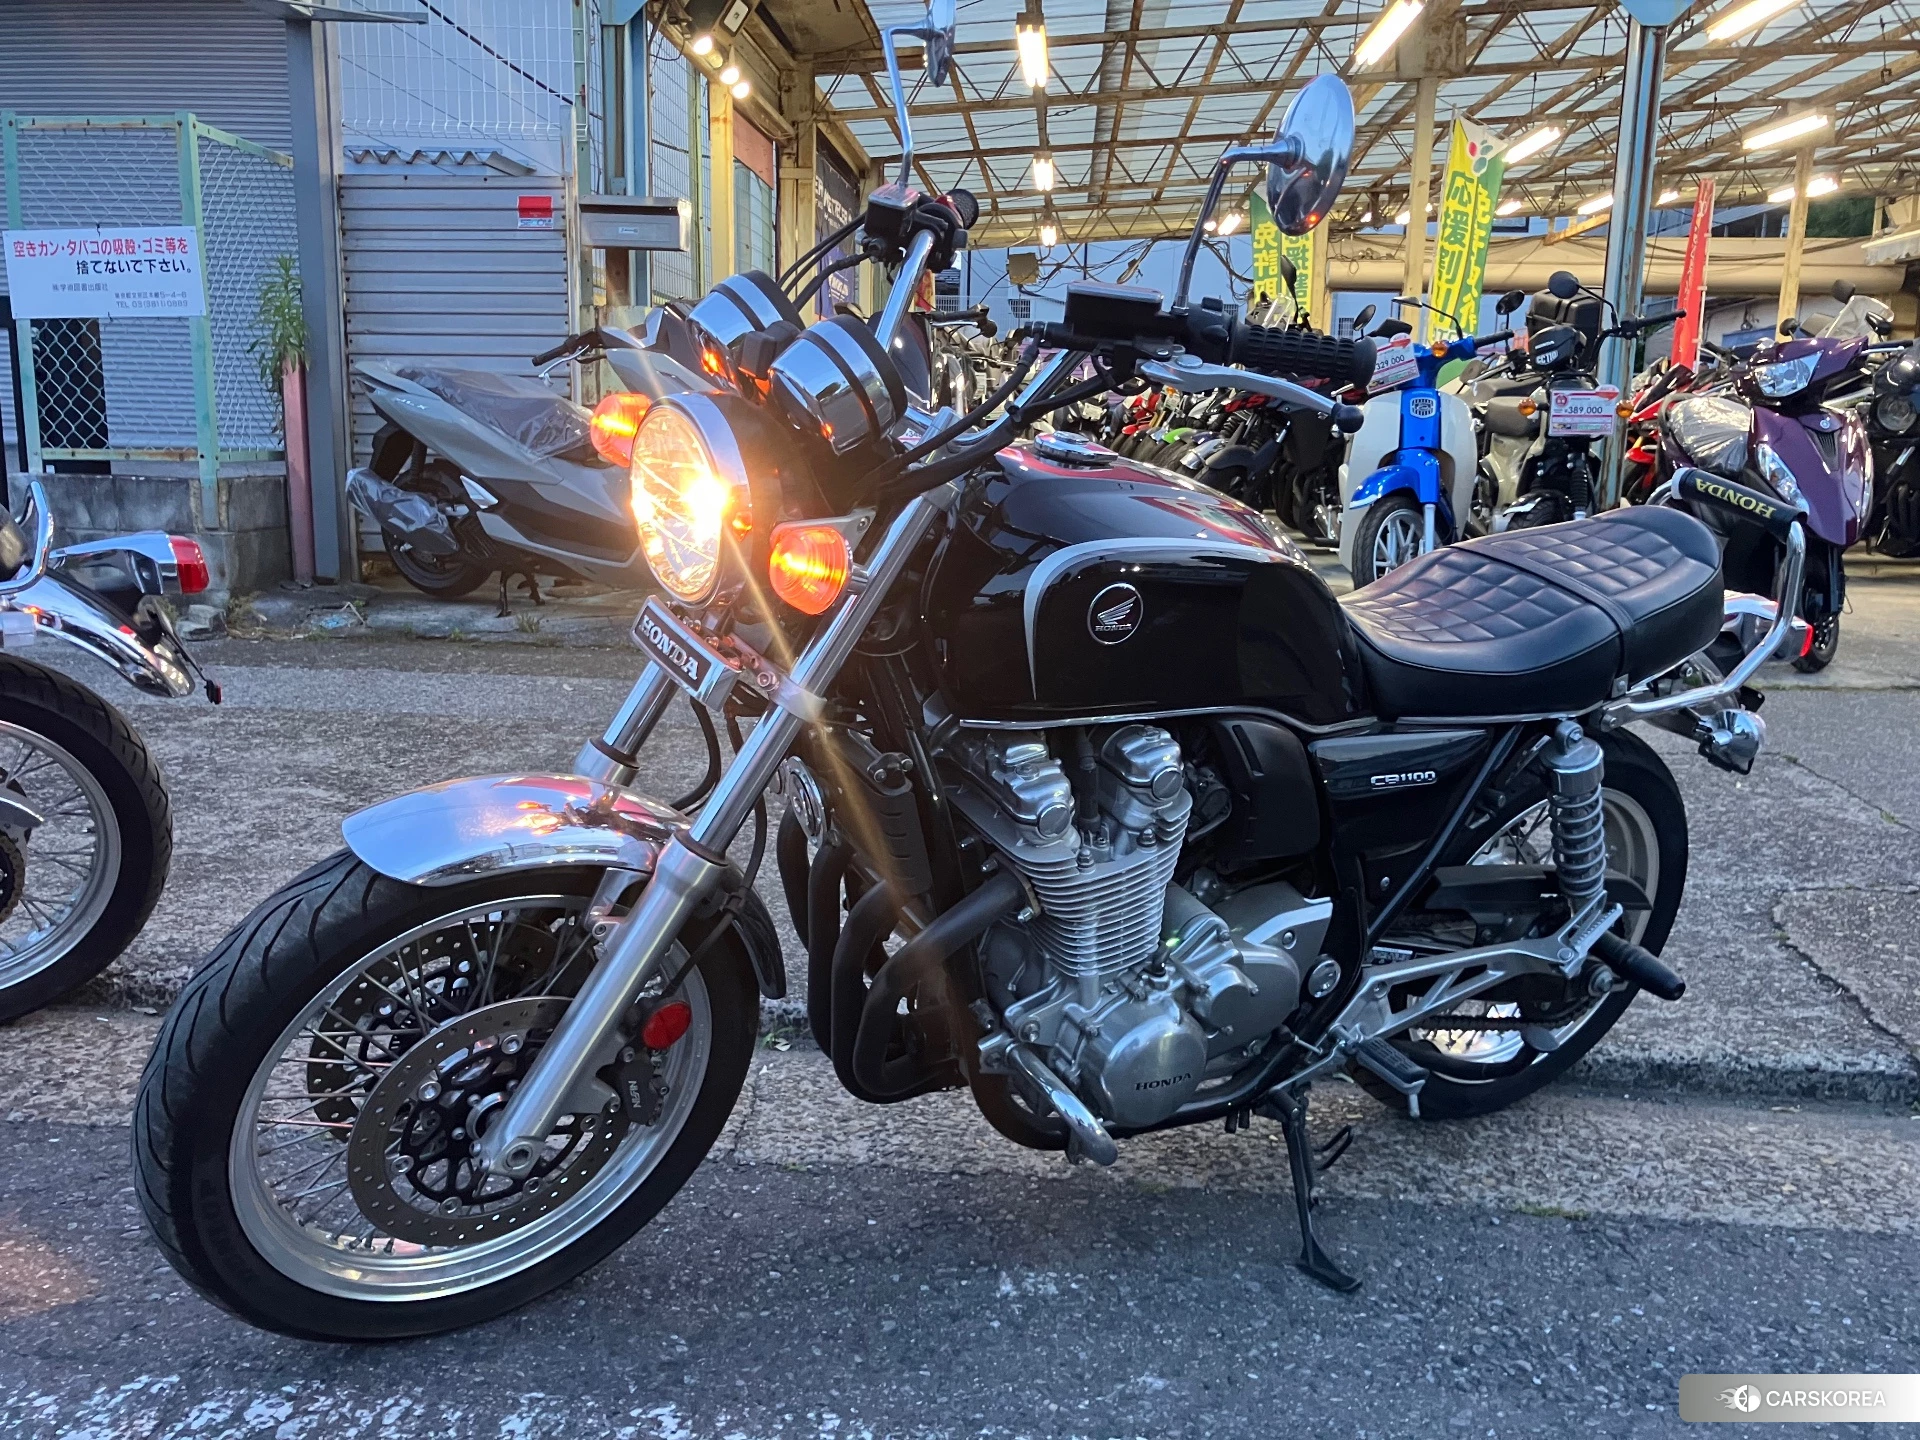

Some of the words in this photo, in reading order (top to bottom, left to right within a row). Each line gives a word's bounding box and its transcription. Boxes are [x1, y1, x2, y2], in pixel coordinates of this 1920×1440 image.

[76, 258, 192, 275] 捨てないで下さい。
[116, 301, 129, 309] TEL
[1695, 478, 1777, 519] HONDA
[1095, 624, 1133, 632] HONDA
[639, 614, 699, 681] HONDA
[1370, 770, 1436, 786] CB1100
[1135, 1072, 1192, 1091] HONDA
